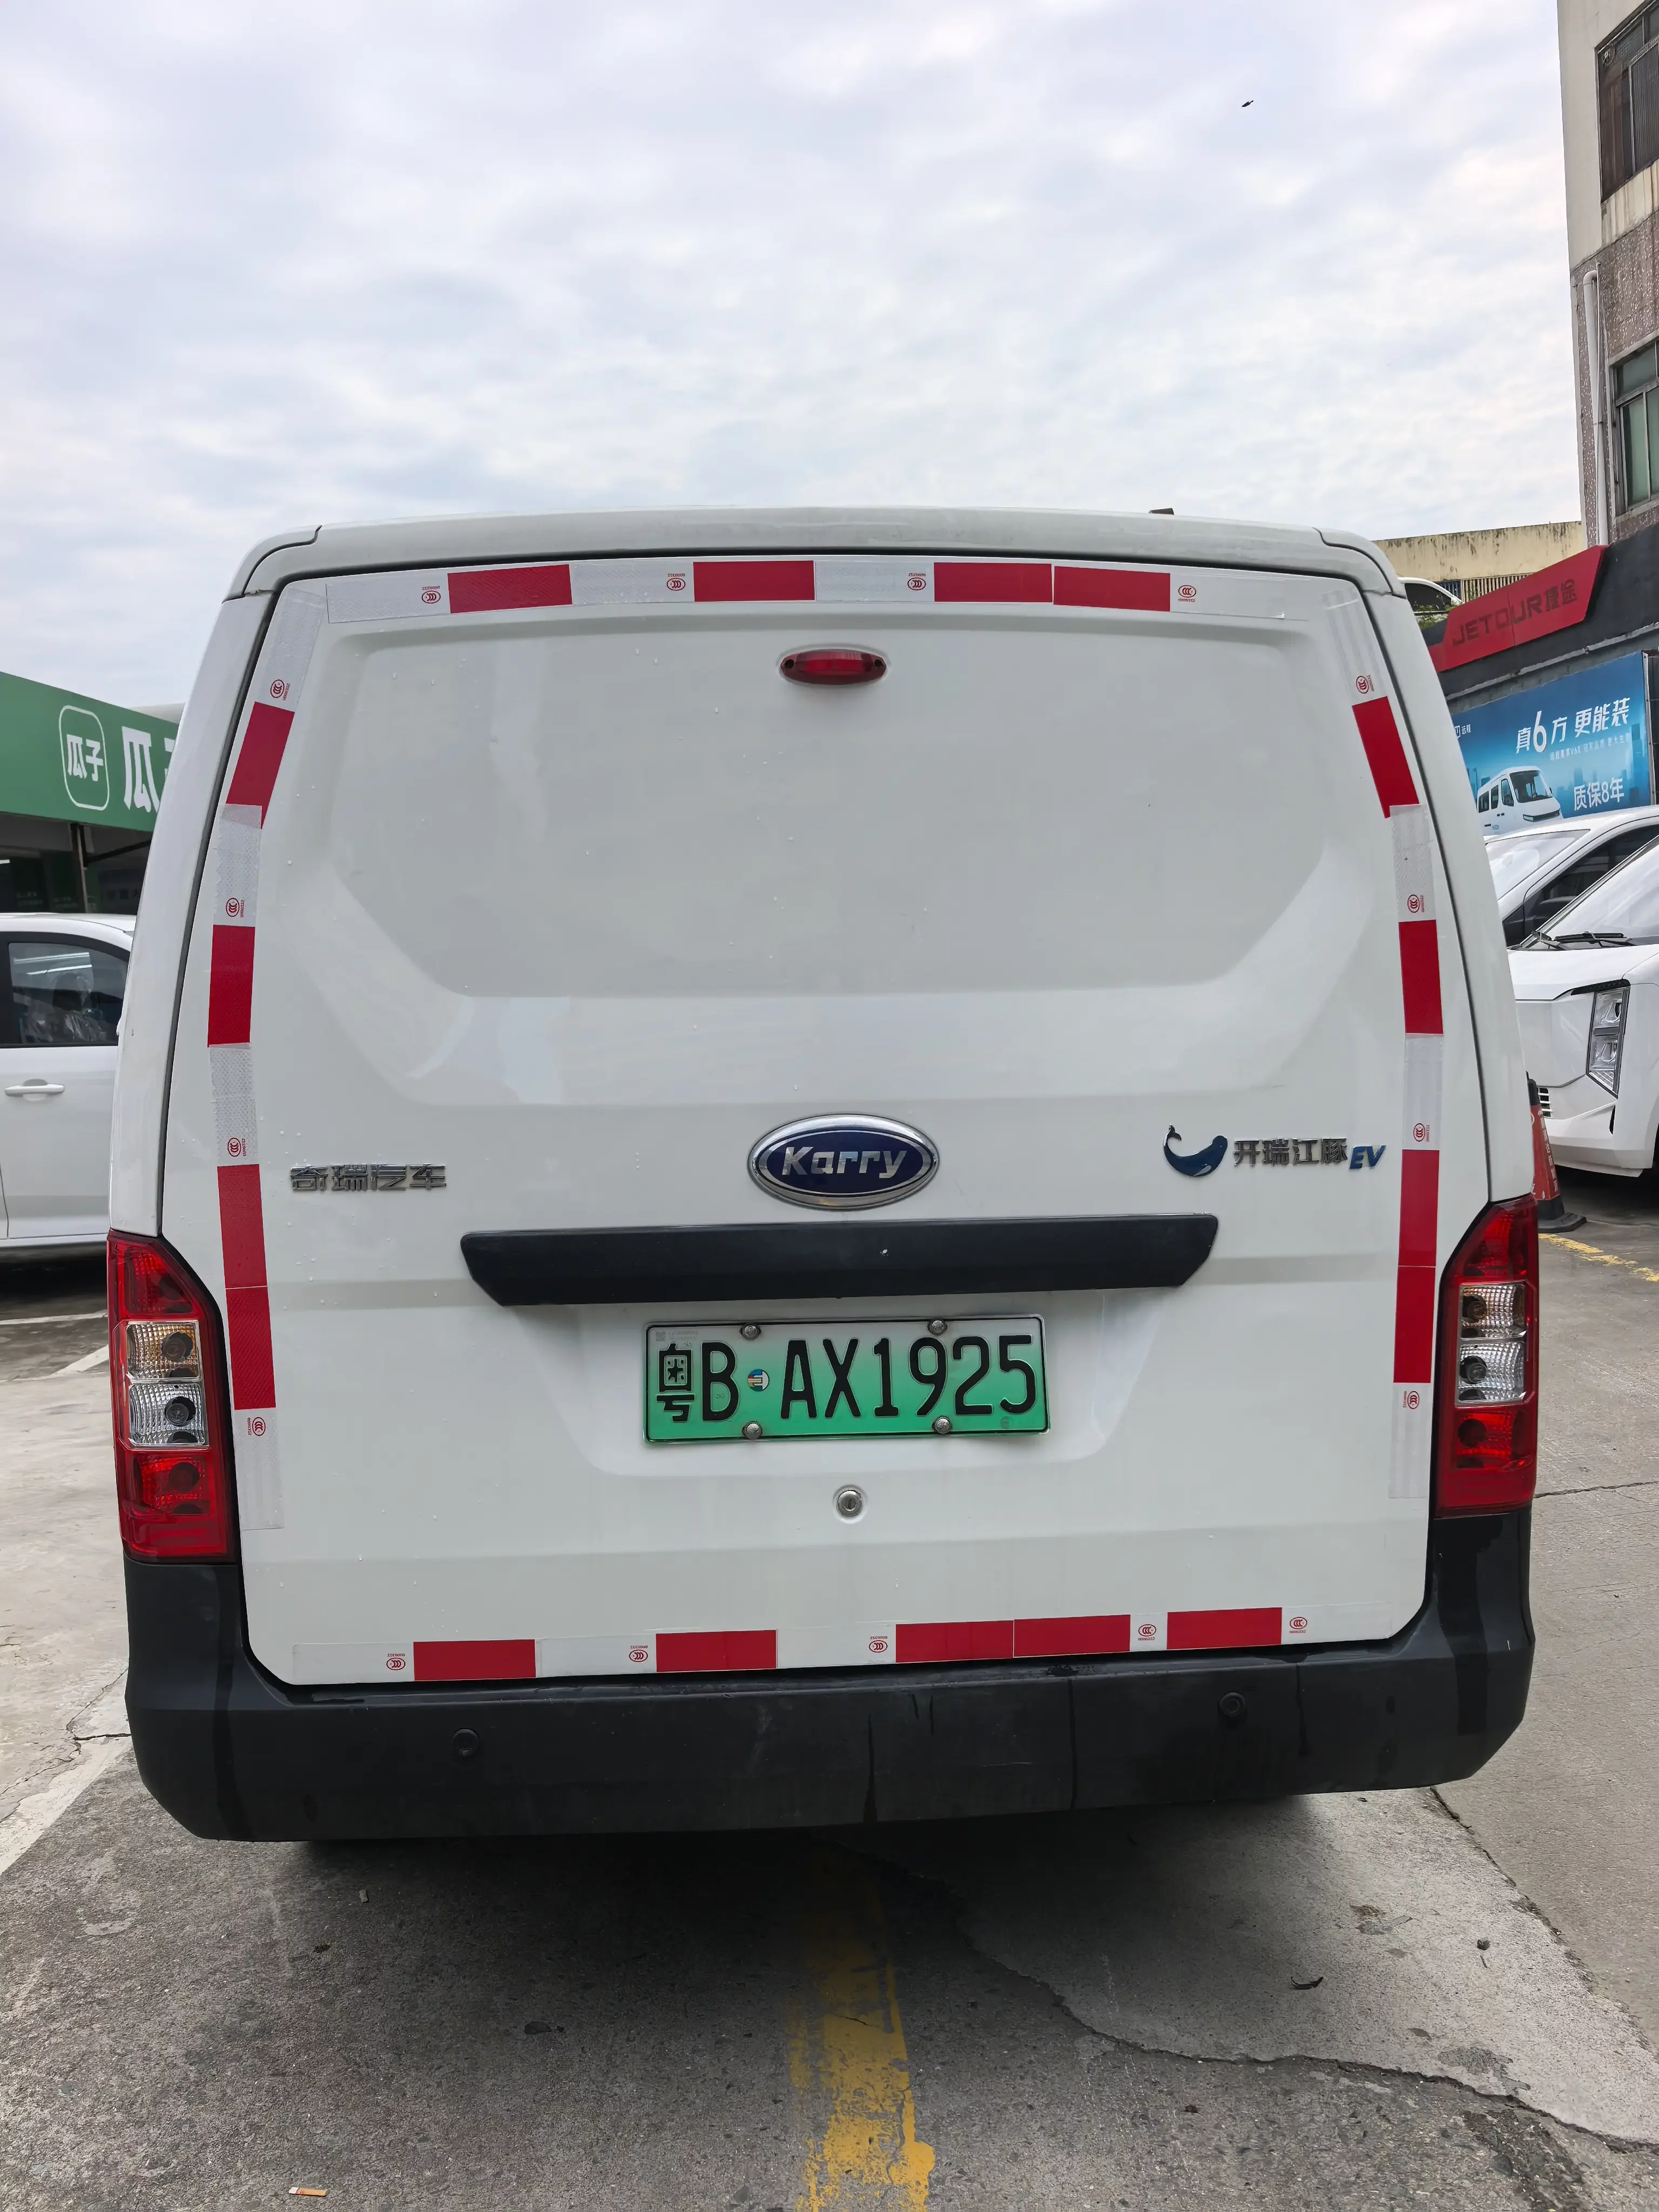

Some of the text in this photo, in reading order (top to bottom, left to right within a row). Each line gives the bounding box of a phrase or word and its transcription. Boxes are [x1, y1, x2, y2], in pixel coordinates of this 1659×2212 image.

[67, 734, 103, 781] 瓜子
[122, 726, 176, 813] 瓜
[1574, 777, 1624, 811] 质保8年
[781, 1146, 907, 1178] Karry
[1233, 1137, 1387, 1169] 开瑞江豚 EV
[289, 1163, 447, 1191] 奇瑞汽车
